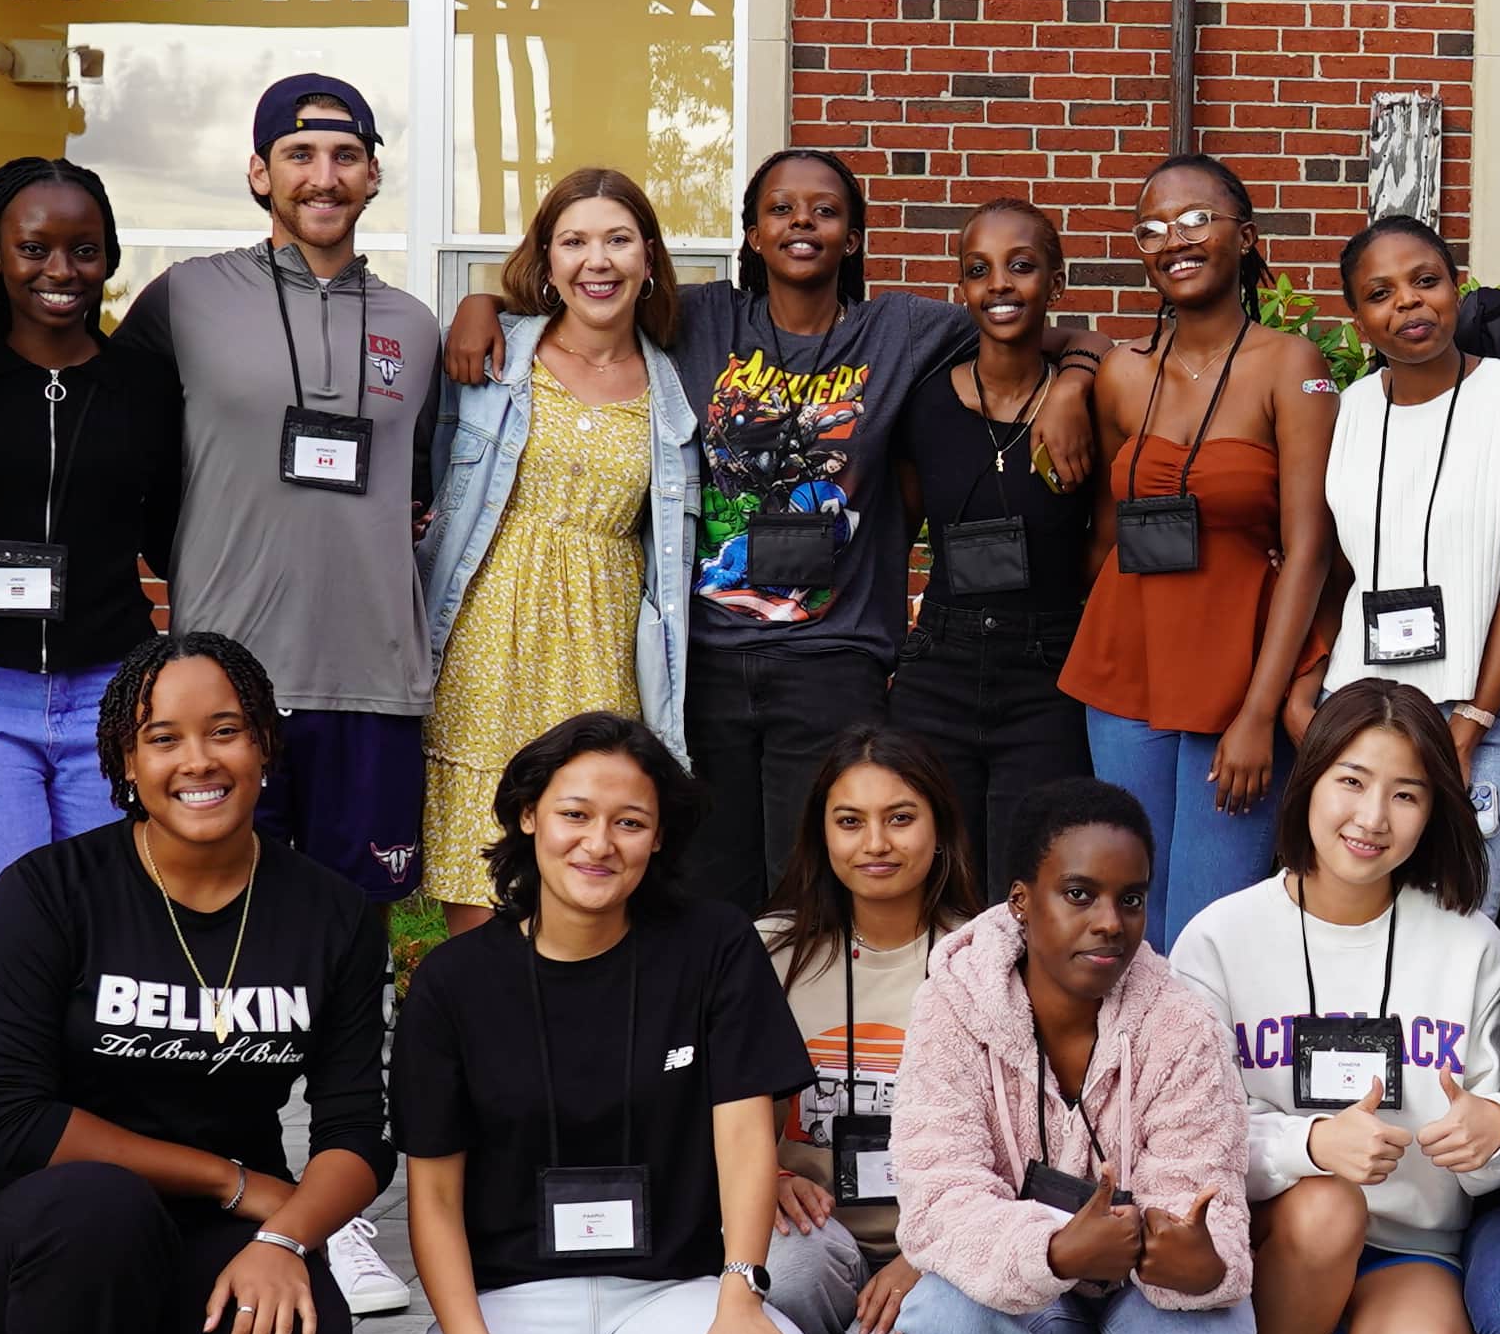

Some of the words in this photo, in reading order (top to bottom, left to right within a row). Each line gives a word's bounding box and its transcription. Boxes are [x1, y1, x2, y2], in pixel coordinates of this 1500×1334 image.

[95, 974, 311, 1033] BELIKIN
[93, 1033, 151, 1058] The
[150, 1038, 209, 1062] Beer
[208, 1036, 251, 1076] of
[242, 1041, 304, 1064] Belize
